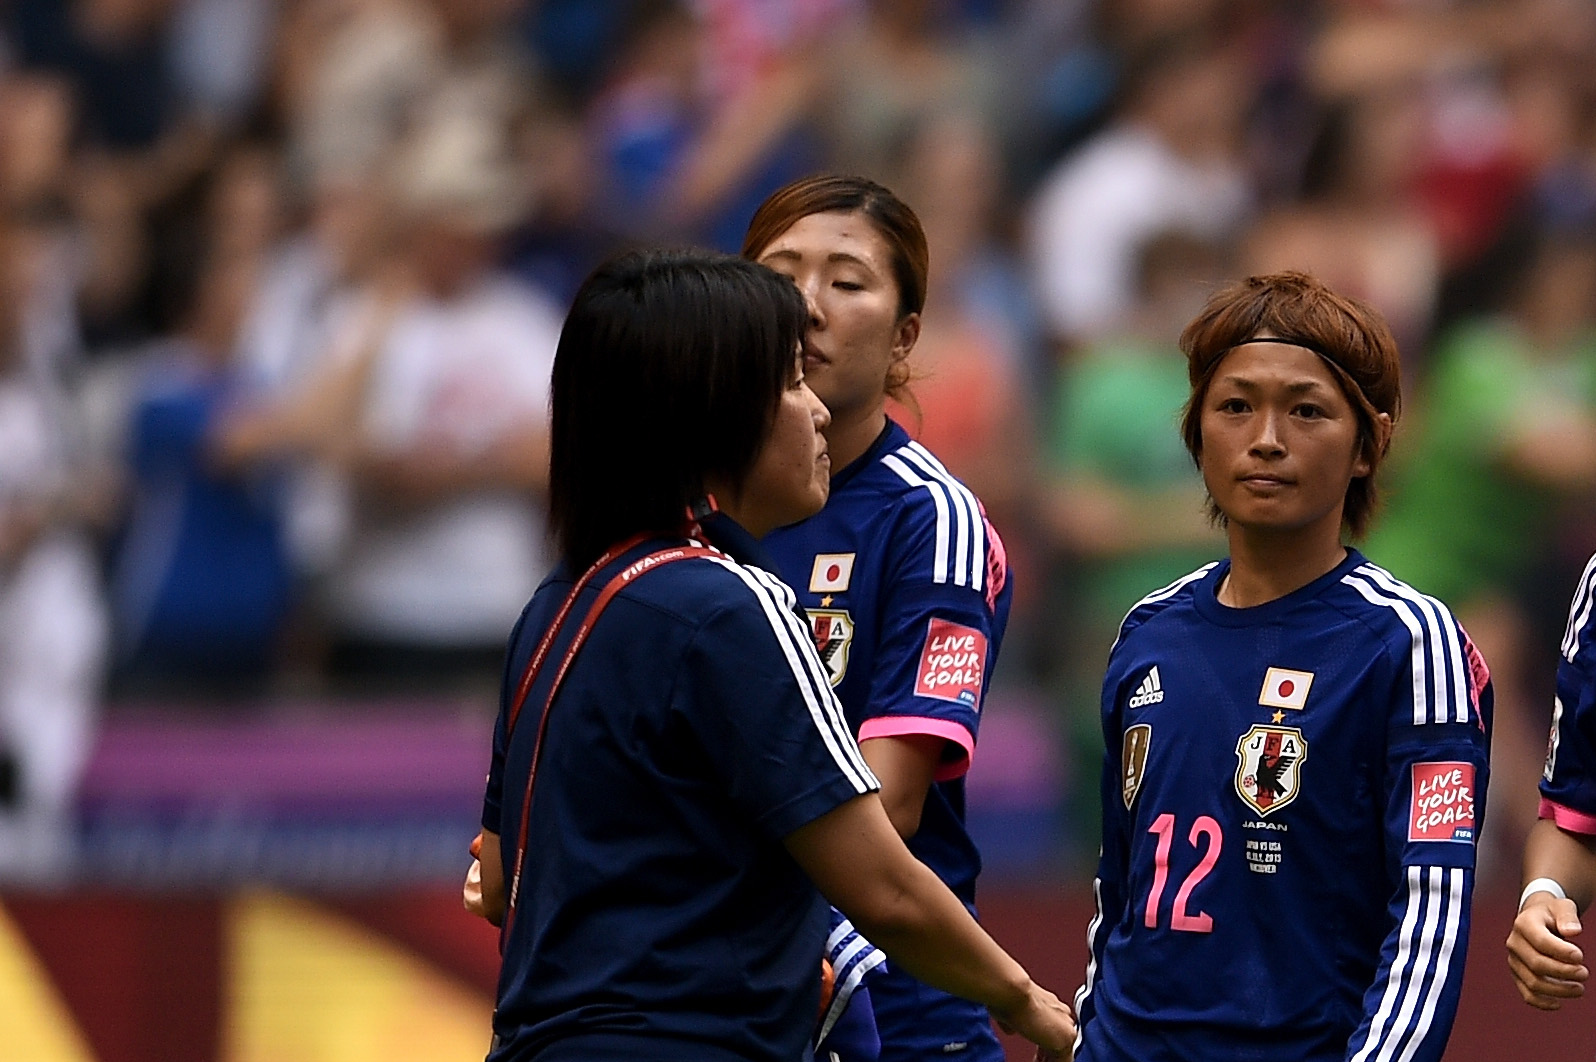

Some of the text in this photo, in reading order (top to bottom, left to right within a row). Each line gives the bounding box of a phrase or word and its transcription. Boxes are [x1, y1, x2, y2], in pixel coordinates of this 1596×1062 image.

[814, 621, 845, 636] FA
[930, 635, 975, 651] LIVE
[927, 653, 980, 671] YOUR
[1129, 691, 1164, 708] adidas
[1251, 735, 1296, 754] JFA
[1419, 769, 1462, 796] LIVE
[1418, 787, 1473, 814] YOUR
[1242, 821, 1288, 831] JAPAN
[1416, 804, 1474, 833] GOALS
[1145, 813, 1223, 932] 12
